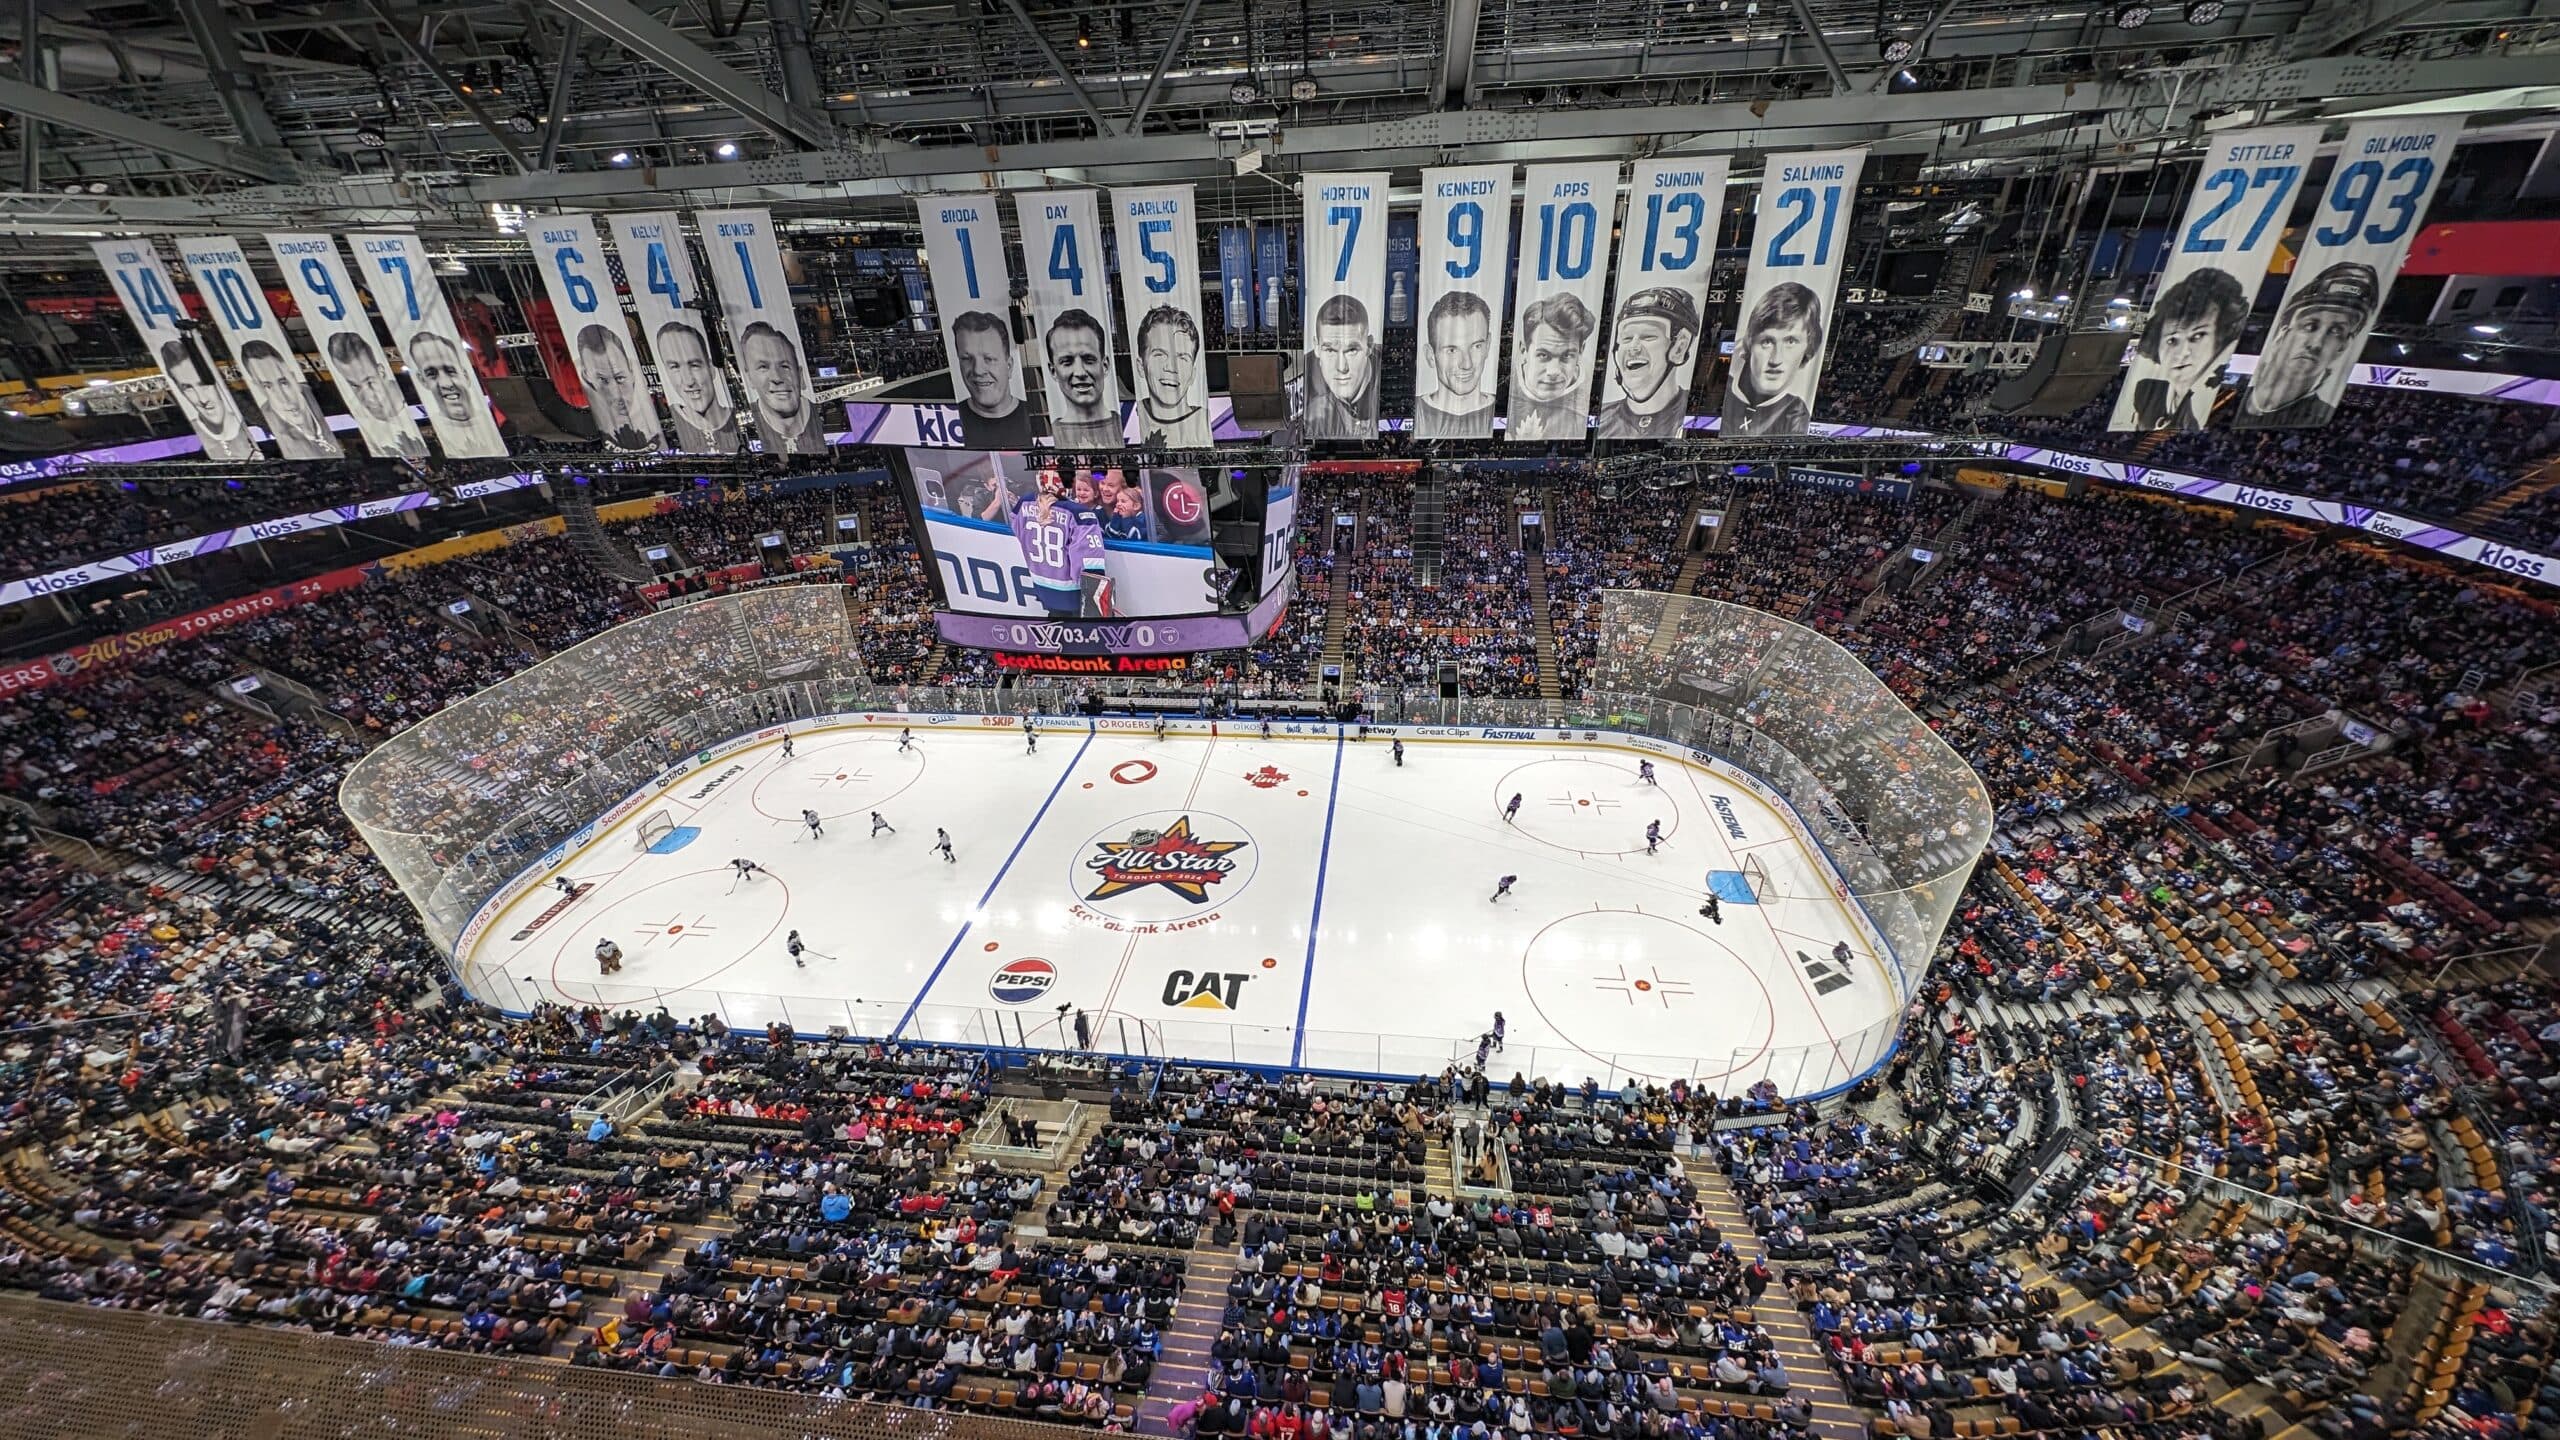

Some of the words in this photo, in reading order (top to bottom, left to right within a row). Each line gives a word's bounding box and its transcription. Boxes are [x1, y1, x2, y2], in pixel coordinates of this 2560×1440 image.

[2228, 144, 2295, 162] SITTLER
[2364, 134, 2436, 154] GILMOUR
[1655, 172, 1704, 188] SUNDIN
[1782, 165, 1844, 182] SALMING
[1321, 186, 1370, 201] HORTON
[1437, 180, 1496, 198] KENNEDY
[1553, 182, 1589, 197] APPS
[1046, 205, 1068, 219] DAY
[1130, 200, 1178, 216] BARILKO
[2182, 165, 2301, 254] 27
[2315, 157, 2434, 247] 93
[941, 208, 978, 223] BRODA
[543, 229, 578, 243] BAILEY
[631, 224, 662, 239] KELLY
[718, 223, 755, 237] BOWER
[1641, 192, 1705, 272] 13
[1766, 186, 1841, 267] 21
[278, 241, 328, 256] CONACHER
[365, 240, 406, 254] CLANCY
[1328, 206, 1362, 281] 7
[1445, 202, 1484, 279] 9
[1537, 202, 1597, 281] 10
[955, 228, 981, 299] 1
[1048, 224, 1082, 296] 4
[1139, 220, 1176, 293] 5
[555, 247, 599, 313] 6
[647, 242, 680, 309] 4
[735, 241, 763, 309] 1
[116, 268, 178, 329] 14
[200, 268, 263, 330] 10
[301, 258, 346, 321] 9
[378, 257, 421, 321] 7
[1, 461, 36, 476] 03.4
[2049, 452, 2091, 473] kloss
[1790, 472, 1855, 488] TORONTO
[1876, 484, 1894, 494] 24
[2147, 476, 2175, 490] kloss
[2234, 487, 2293, 512] kloss
[251, 519, 302, 540] kloss
[2372, 520, 2402, 538] kloss
[1026, 521, 1064, 568] 38
[1086, 534, 1103, 548] 38
[159, 550, 192, 563] kloss
[2478, 542, 2545, 577] kloss
[25, 569, 90, 596] kloss
[76, 639, 122, 669] All
[125, 627, 178, 654] Star
[181, 596, 274, 631] TORONTO
[301, 582, 321, 595] 24
[1011, 624, 1028, 646] 0
[1063, 628, 1099, 643] 03.4
[1136, 626, 1154, 646] 0
[993, 652, 1112, 671] Scotiabank
[1118, 655, 1186, 672] Arena
[991, 716, 1014, 727] SKIP
[1046, 719, 1081, 727] FANDUEL
[1111, 720, 1150, 729] ROGERS
[758, 727, 785, 740] ESPN
[1417, 728, 1444, 736] Great
[1446, 728, 1470, 737] Clips
[1481, 728, 1536, 740] FASTENAL
[1692, 751, 1713, 764] SN
[688, 764, 745, 800] betway
[601, 791, 648, 827] Scotiabank
[1709, 794, 1746, 842] FASTENAL
[575, 830, 593, 847] SAP
[546, 851, 565, 868] SAP
[1114, 873, 1161, 881] TORONTO
[1069, 904, 1159, 934] Scoabnk
[1165, 912, 1221, 933] Arena
[462, 911, 490, 951] ROGERS
[995, 974, 1051, 988] PEPSI
[1162, 970, 1249, 1010] CAT
[1388, 1303, 1400, 1313] 18
